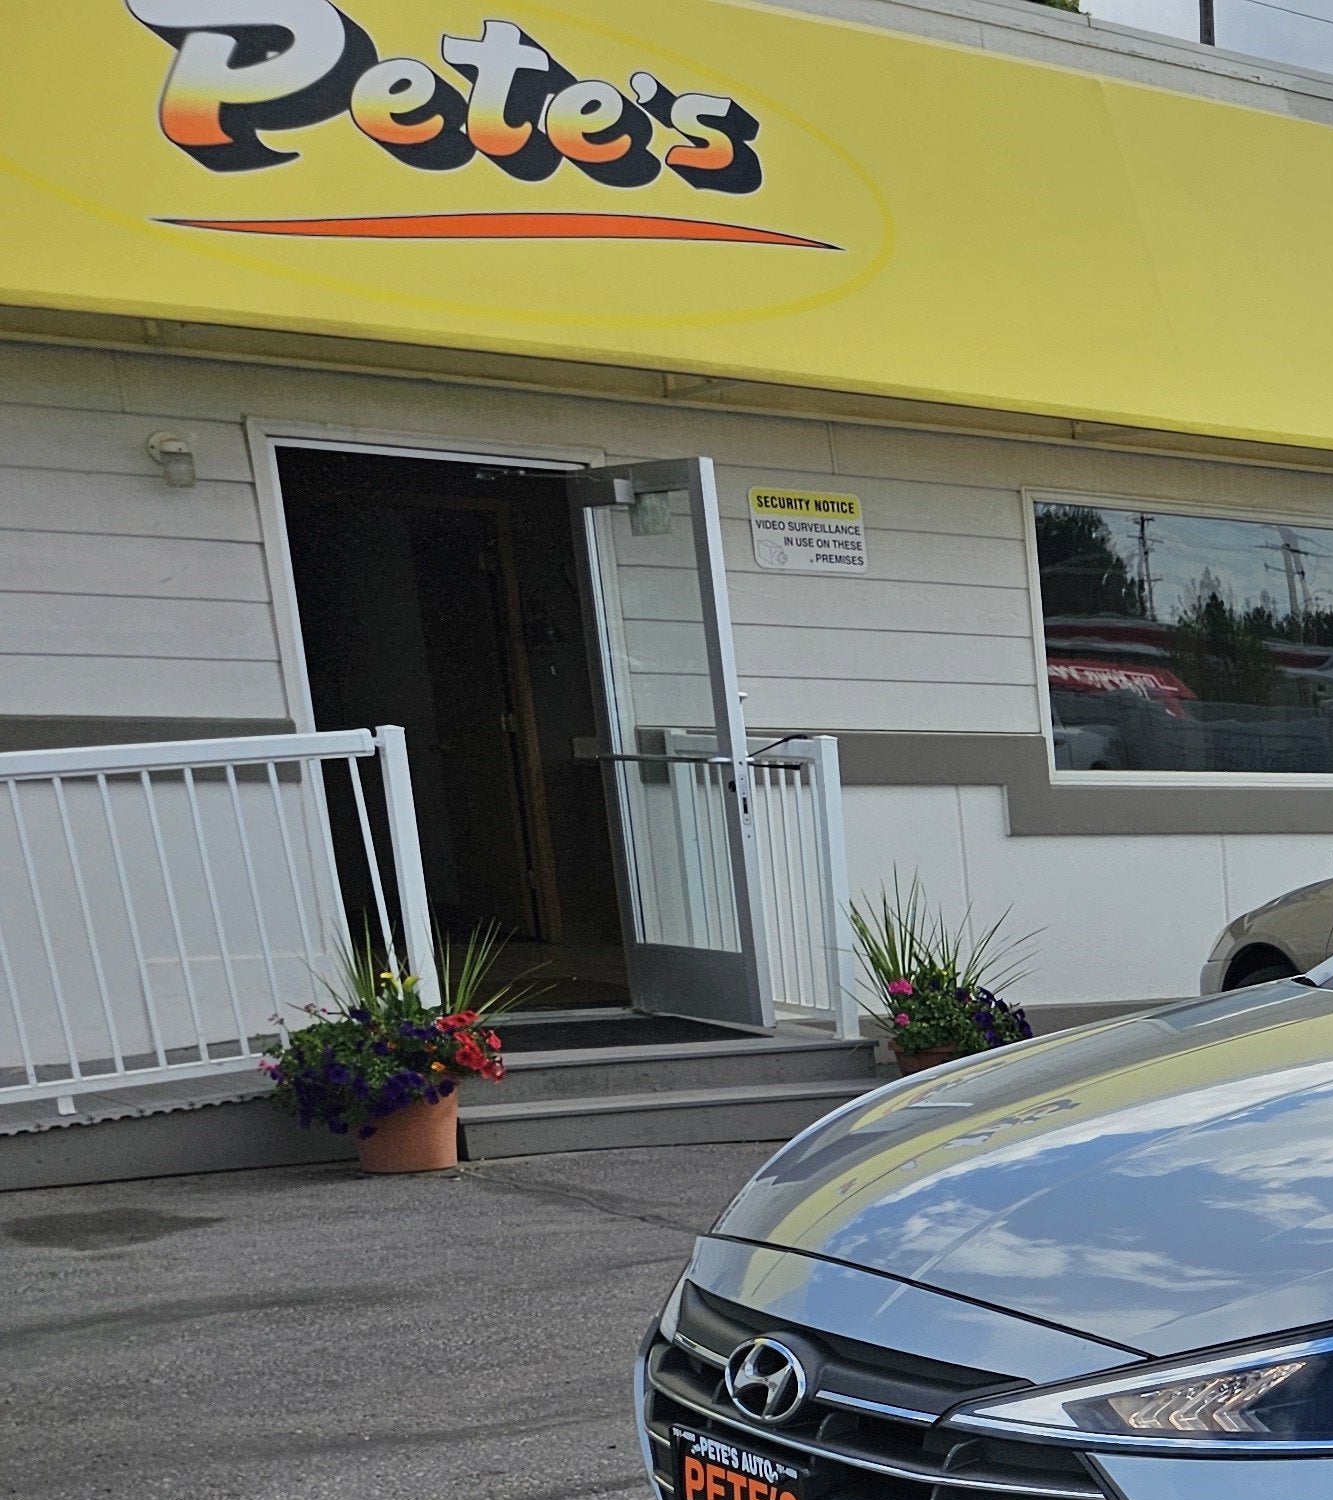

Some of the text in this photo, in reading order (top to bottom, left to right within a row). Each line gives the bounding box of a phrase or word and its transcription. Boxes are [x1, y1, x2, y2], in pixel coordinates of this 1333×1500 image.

[125, 0, 750, 184] Pete's
[756, 495, 855, 514] SECURITY NOTICE
[755, 519, 861, 536] VIDEO SURVEILLANCE
[784, 536, 863, 551] IN USE ON THESE
[815, 553, 865, 566] PREMISES
[700, 1436, 740, 1470] PETE'S
[742, 1451, 774, 1483] AUTO
